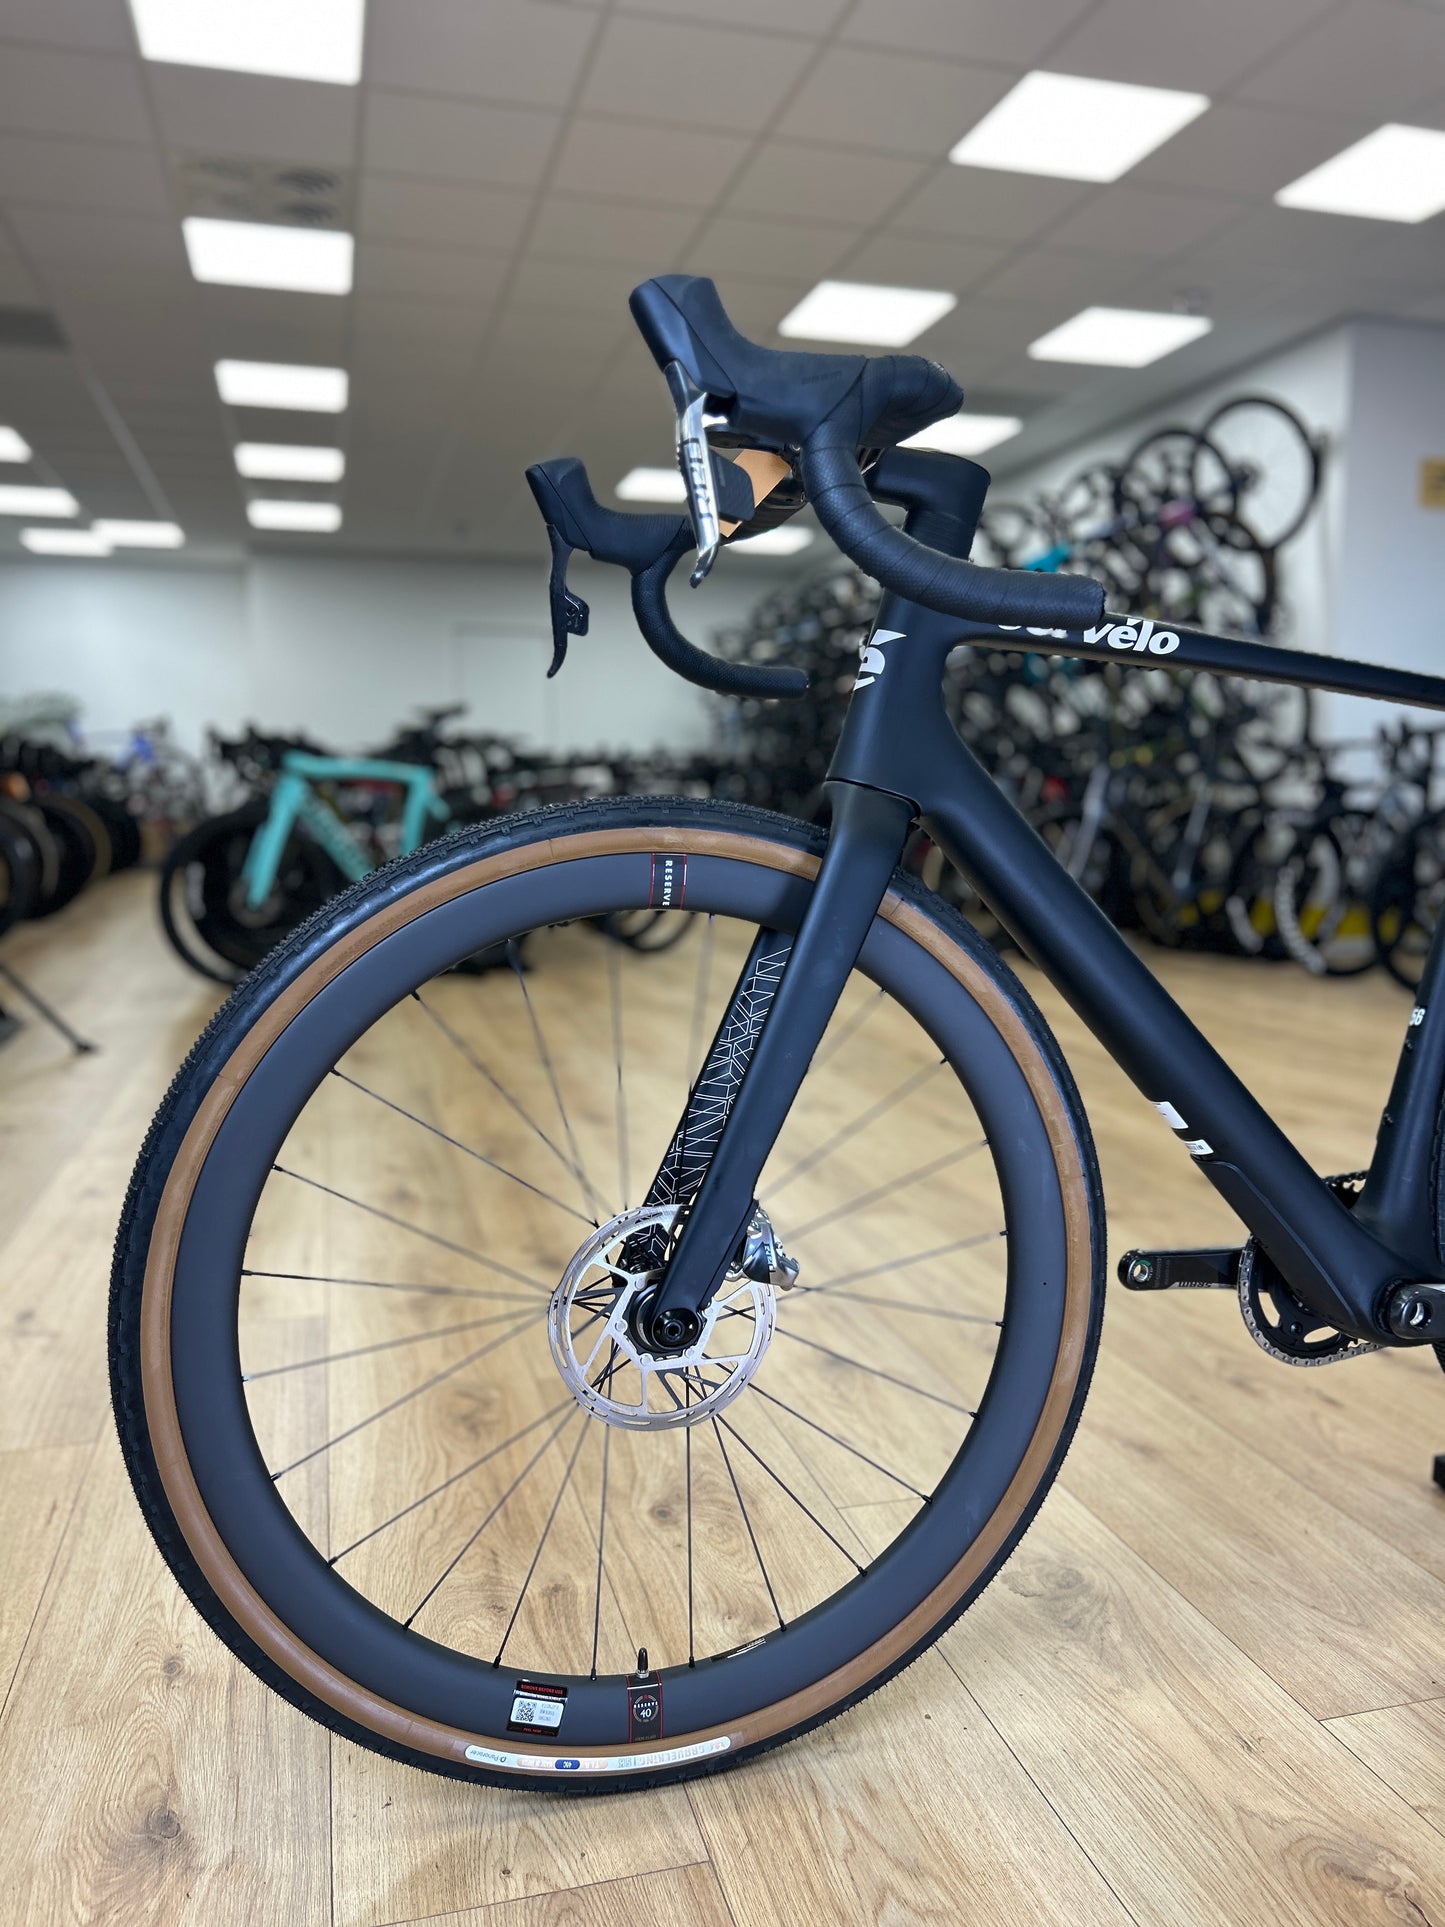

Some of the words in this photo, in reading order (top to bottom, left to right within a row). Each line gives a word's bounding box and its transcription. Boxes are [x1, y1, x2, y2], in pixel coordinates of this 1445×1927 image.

[998, 617, 1181, 655] vélo
[662, 860, 673, 906] RESERVE
[640, 1708, 652, 1718] 40
